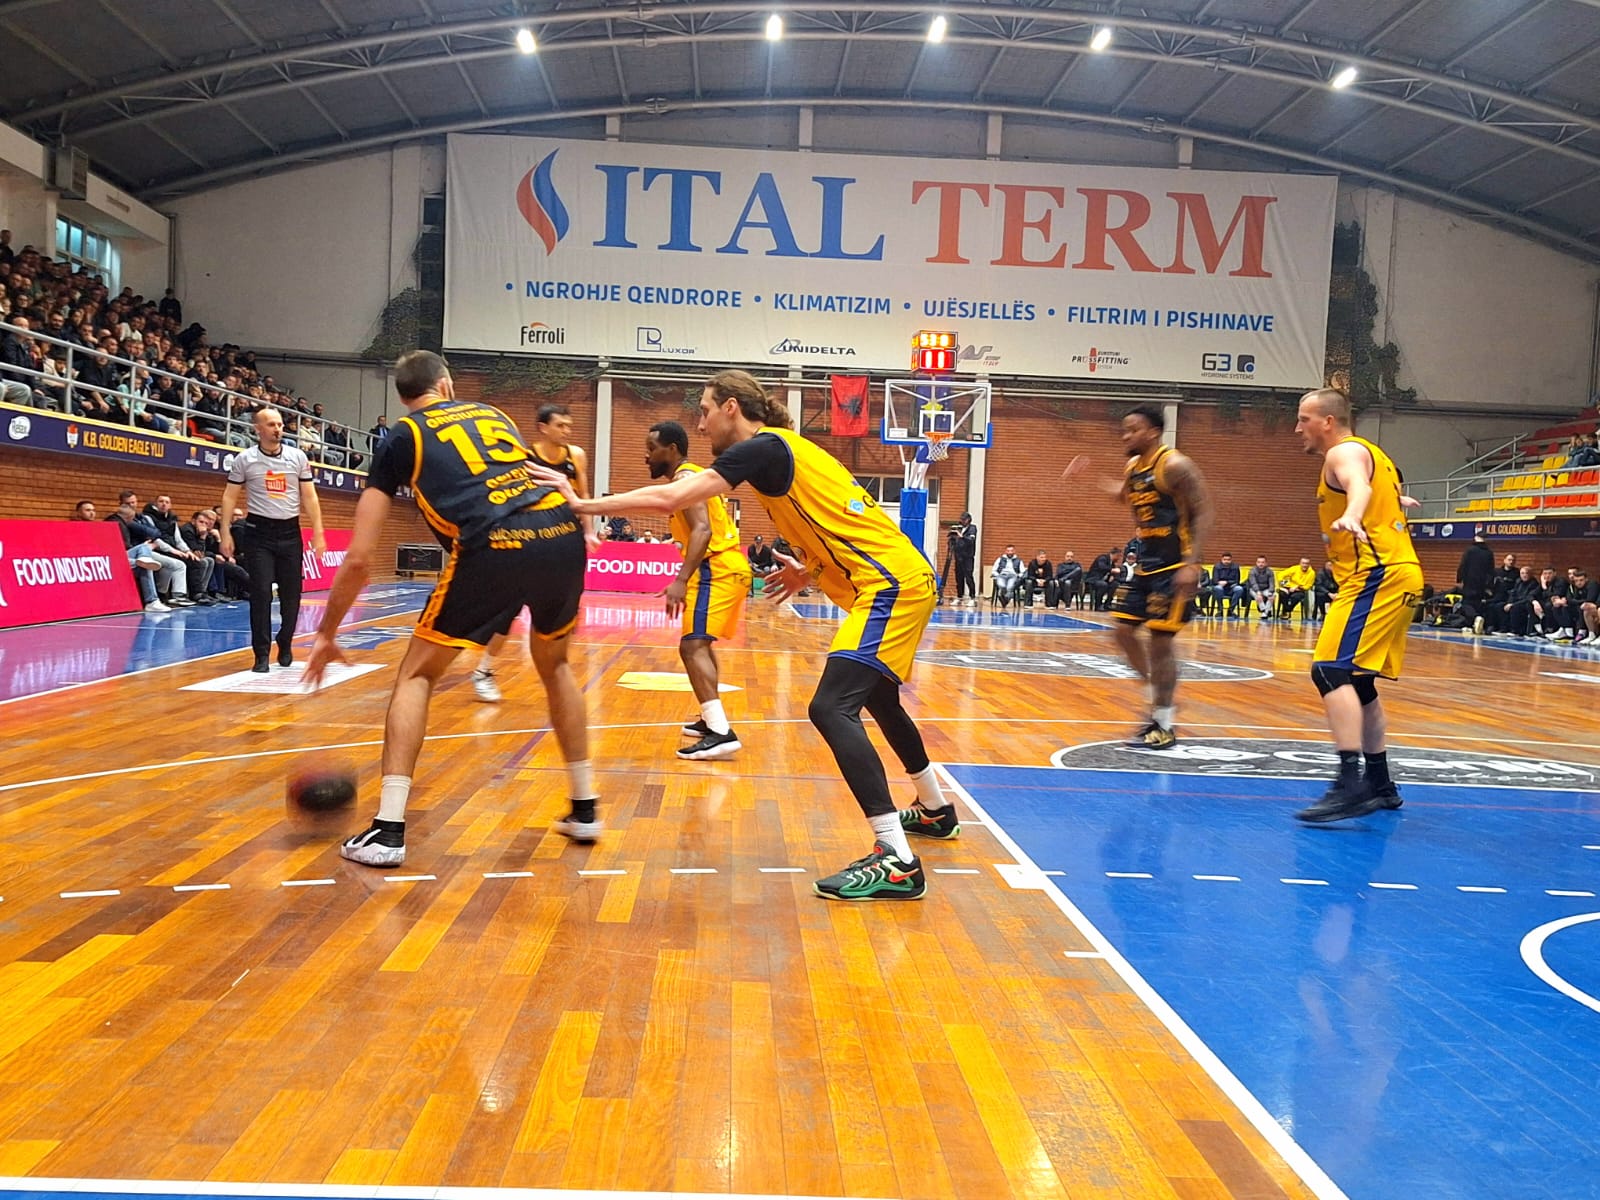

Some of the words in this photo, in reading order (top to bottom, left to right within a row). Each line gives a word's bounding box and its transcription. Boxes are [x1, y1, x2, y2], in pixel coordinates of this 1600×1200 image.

[593, 164, 885, 261] ITAL
[911, 180, 1278, 278] TERM
[526, 280, 621, 301] NGROHJE
[627, 286, 742, 307] QENDRORE
[774, 293, 890, 315] KLIMATIZIM
[924, 298, 1036, 321] UJËSJELLËS
[1067, 306, 1147, 326] FILTRIM
[1154, 310, 1159, 327] I
[1166, 310, 1274, 332] PISHINAVE
[520, 326, 565, 346] Ferroli
[783, 344, 856, 355] UNIDELTA
[1201, 353, 1232, 371] G3
[99, 433, 128, 453] GOLDEN
[128, 438, 150, 456] EAGLE
[436, 419, 528, 476] 15
[1498, 523, 1522, 535] GOLDEN
[12, 557, 56, 587] FOOD
[53, 555, 113, 584] INDUSTRY
[587, 558, 634, 574] FOOD
[637, 561, 684, 576] INDUS
